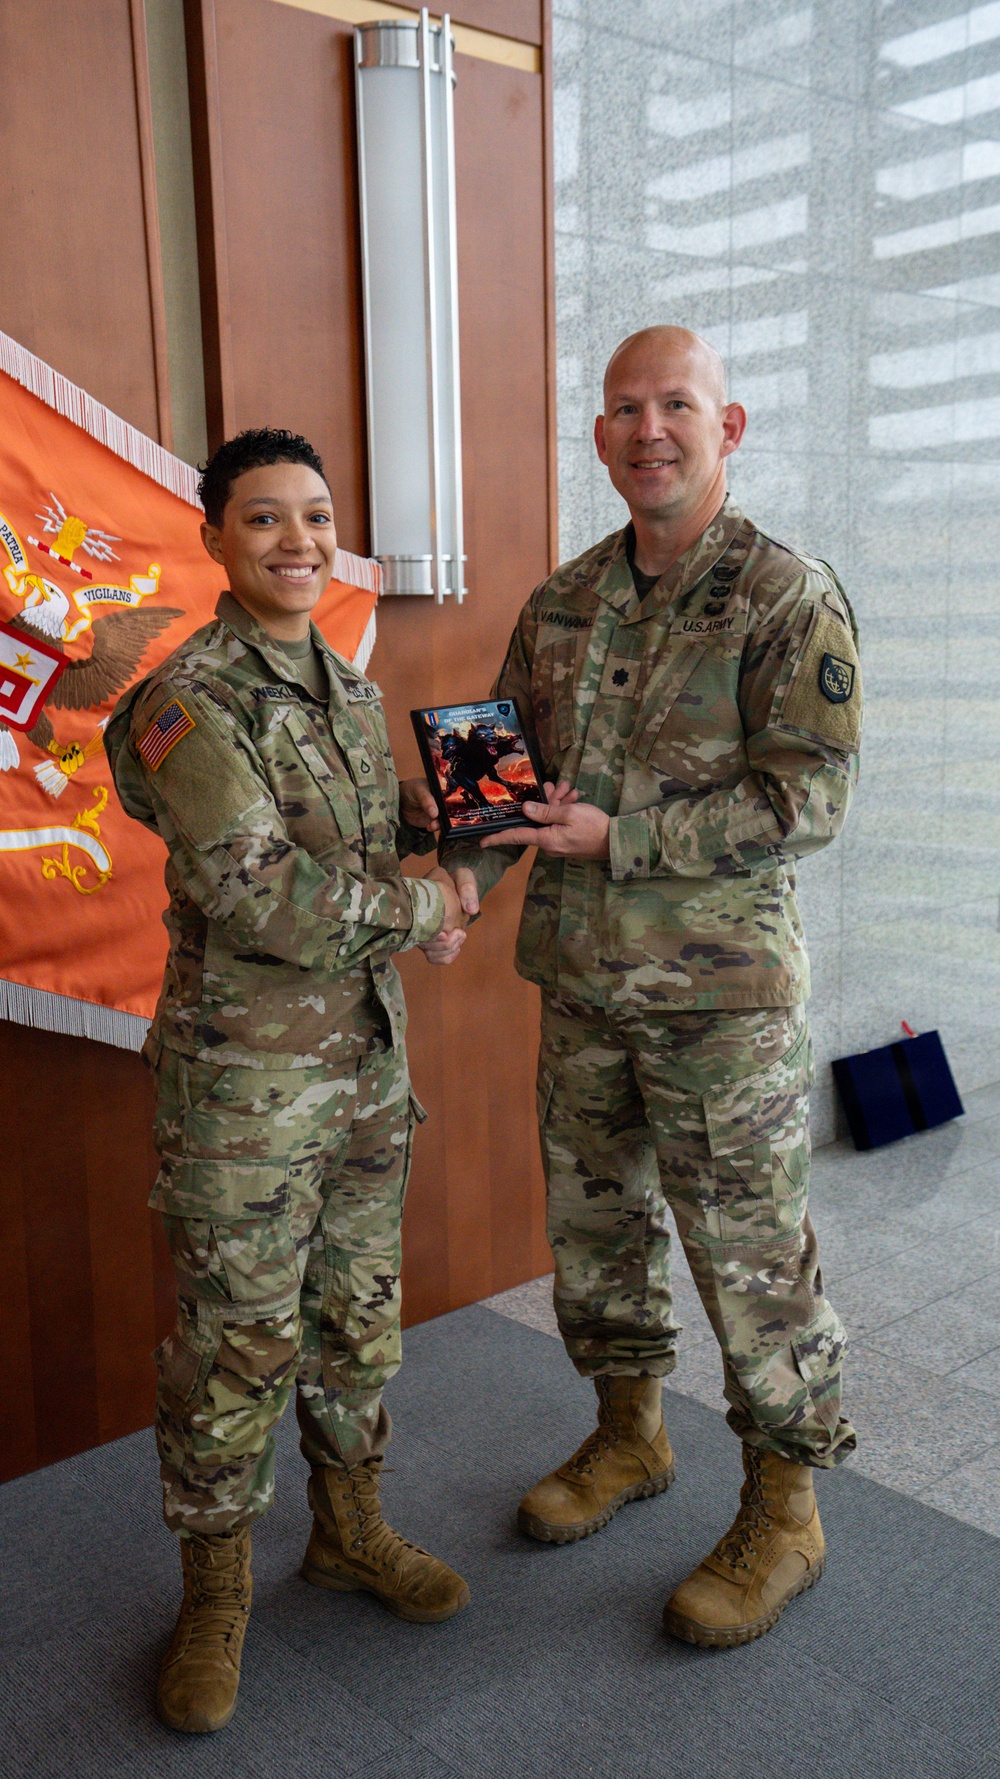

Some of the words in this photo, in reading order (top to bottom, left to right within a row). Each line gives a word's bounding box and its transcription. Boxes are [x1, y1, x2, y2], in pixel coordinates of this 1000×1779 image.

[0, 524, 23, 564] PATRIA
[84, 588, 131, 603] VIGILANS
[449, 707, 487, 717] GUARDIAN'S
[467, 712, 495, 721] GATEWAY
